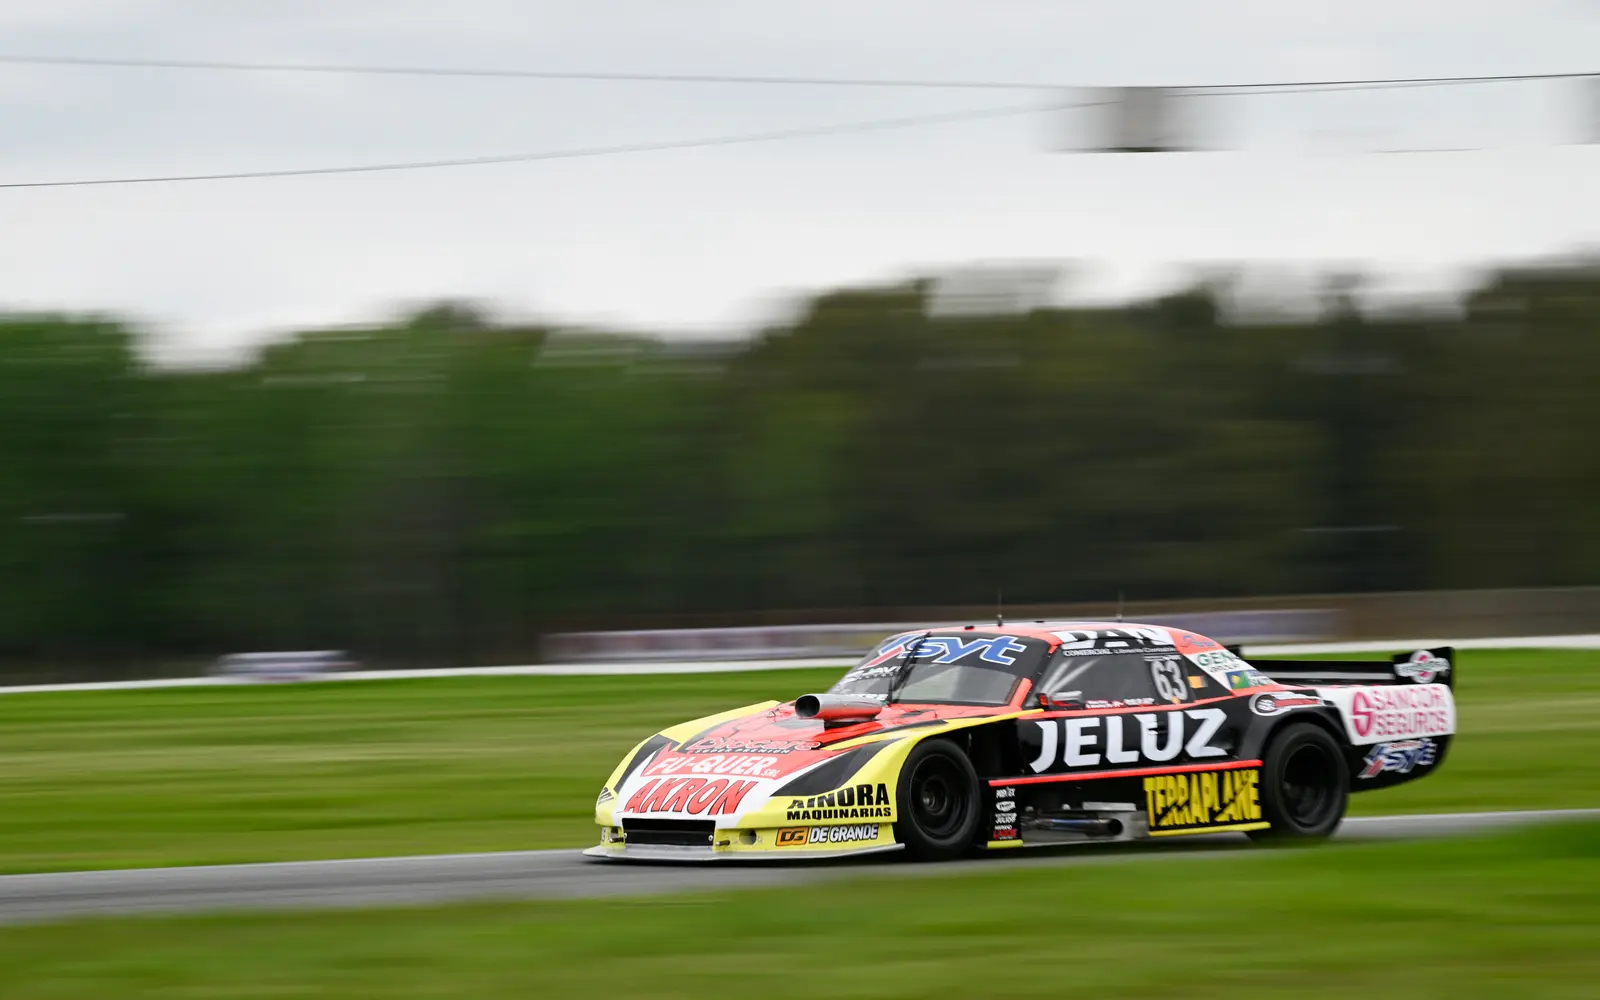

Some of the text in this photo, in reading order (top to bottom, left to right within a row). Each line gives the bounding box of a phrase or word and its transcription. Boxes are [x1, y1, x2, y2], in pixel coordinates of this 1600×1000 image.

[1151, 660, 1188, 701] 63
[1373, 686, 1446, 712] SANCOR
[1375, 710, 1449, 736] SEGUROS
[1029, 708, 1228, 774] JELUZ
[647, 754, 778, 778] FU-QUER
[624, 777, 759, 816] AKRON
[1143, 769, 1262, 827] TERRAPLANE
[786, 807, 891, 820] MAQUINARIAS
[809, 823, 878, 843] DE GRANDE
